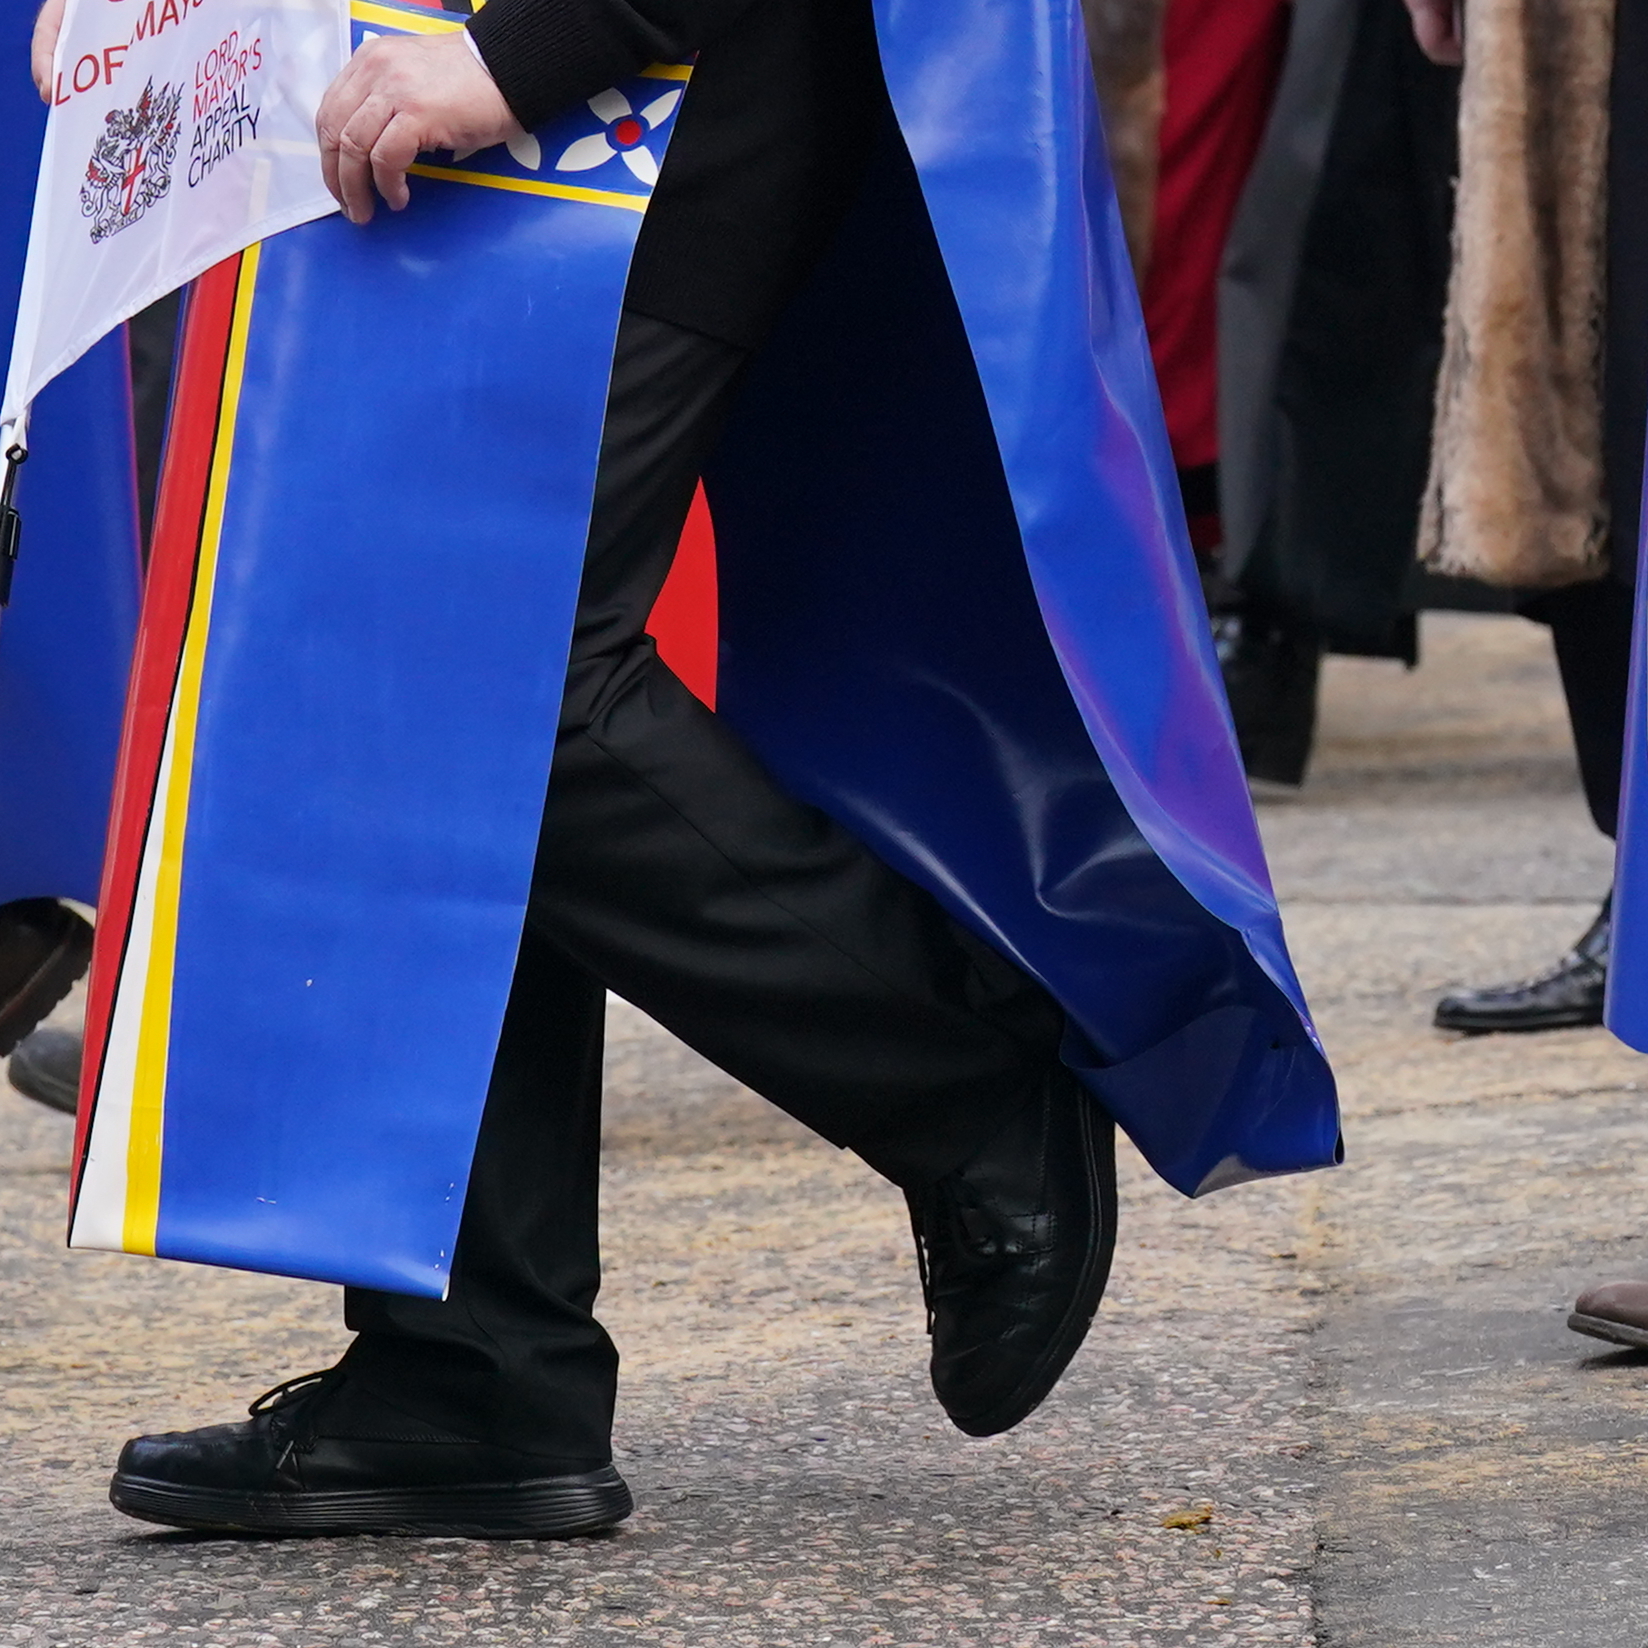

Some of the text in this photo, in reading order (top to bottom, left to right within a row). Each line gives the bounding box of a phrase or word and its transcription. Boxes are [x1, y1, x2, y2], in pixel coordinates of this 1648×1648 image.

[192, 37, 263, 123] MAYOR'S
[194, 29, 238, 90] LORD
[187, 107, 260, 188] CHARITY
[190, 83, 251, 158] APPEAL
